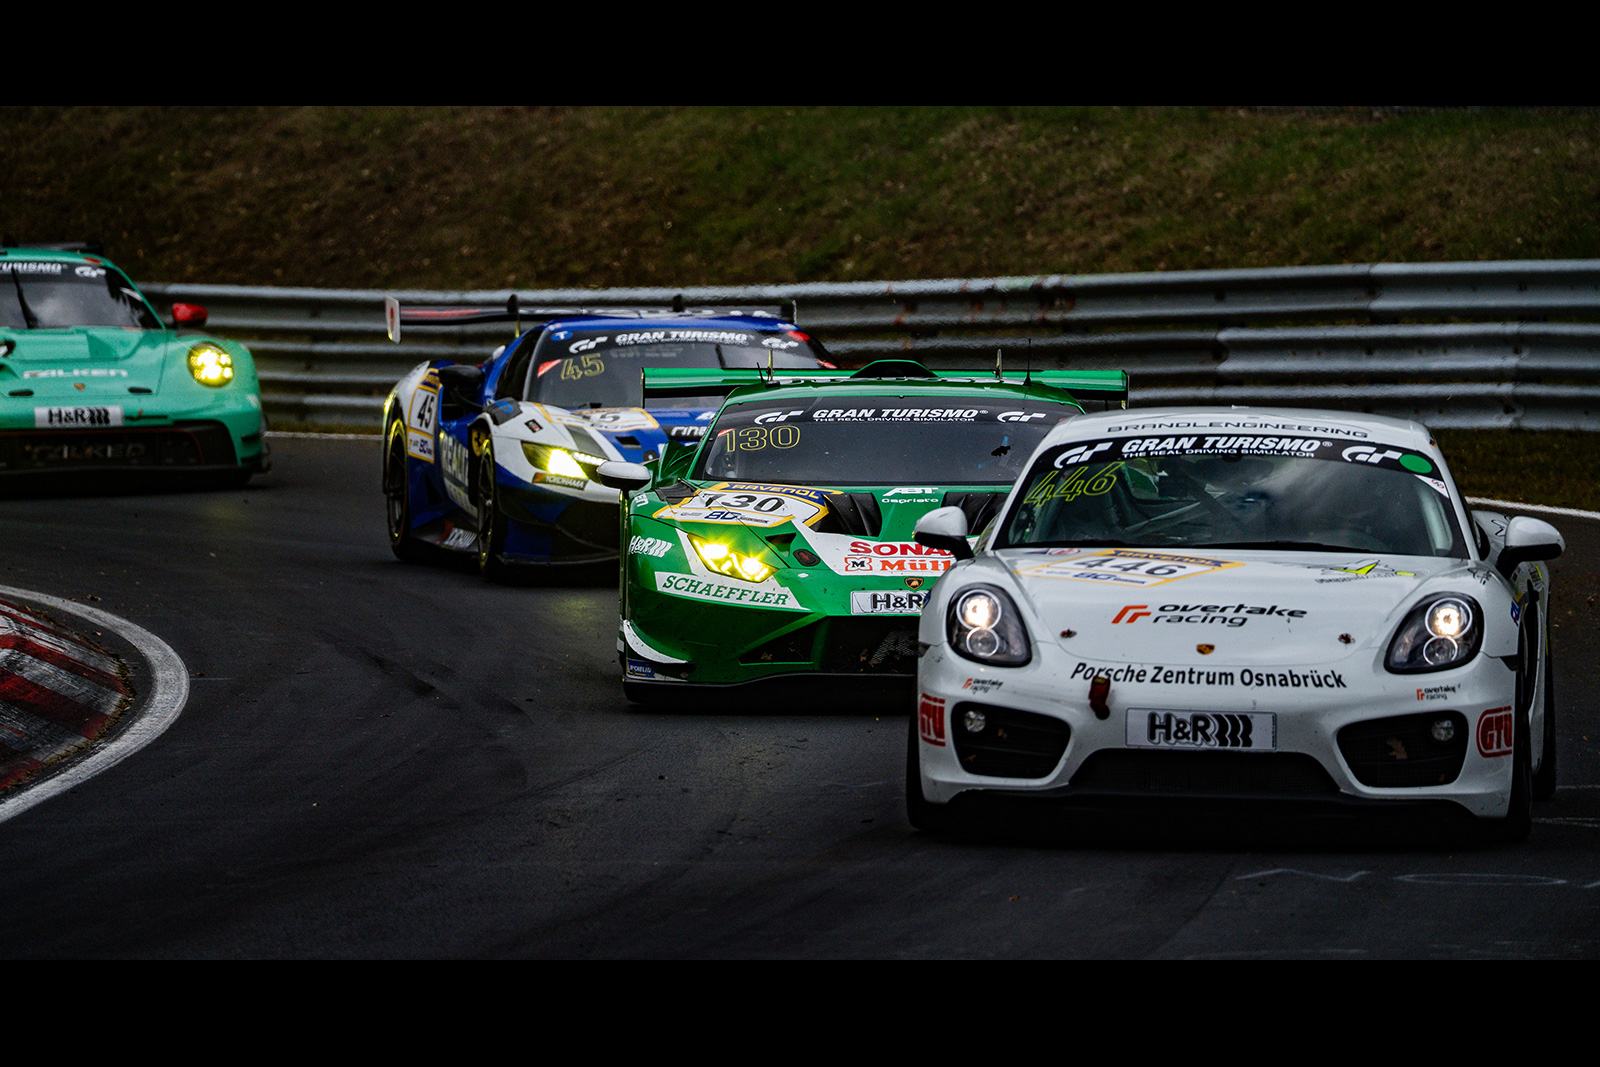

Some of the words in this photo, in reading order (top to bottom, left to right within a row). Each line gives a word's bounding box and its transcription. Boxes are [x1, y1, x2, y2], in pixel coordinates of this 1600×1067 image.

[0, 262, 62, 271] URISMO
[615, 331, 665, 343] GRAN
[560, 352, 605, 380] 45
[417, 394, 435, 429] 45
[812, 409, 874, 418] GRAN
[722, 425, 801, 453] 130
[1121, 437, 1198, 453] GRAN
[1151, 450, 1186, 458] REAL
[1241, 449, 1315, 458] SIMULATOR
[732, 483, 821, 499] RAVENOL
[882, 487, 939, 497] ABT
[1023, 461, 1126, 507] 446
[702, 493, 785, 512] 130
[850, 541, 953, 556] SONA
[1074, 558, 1187, 575] 446
[662, 575, 789, 605] SCHAEFFLER
[872, 594, 923, 609] H&R
[1158, 604, 1307, 618] overtake
[1153, 613, 1248, 627] racing
[1070, 662, 1147, 683] Porsche
[1150, 666, 1235, 686] Zentrum
[1240, 669, 1348, 689] Osnabrück
[1149, 713, 1214, 743] H&R
